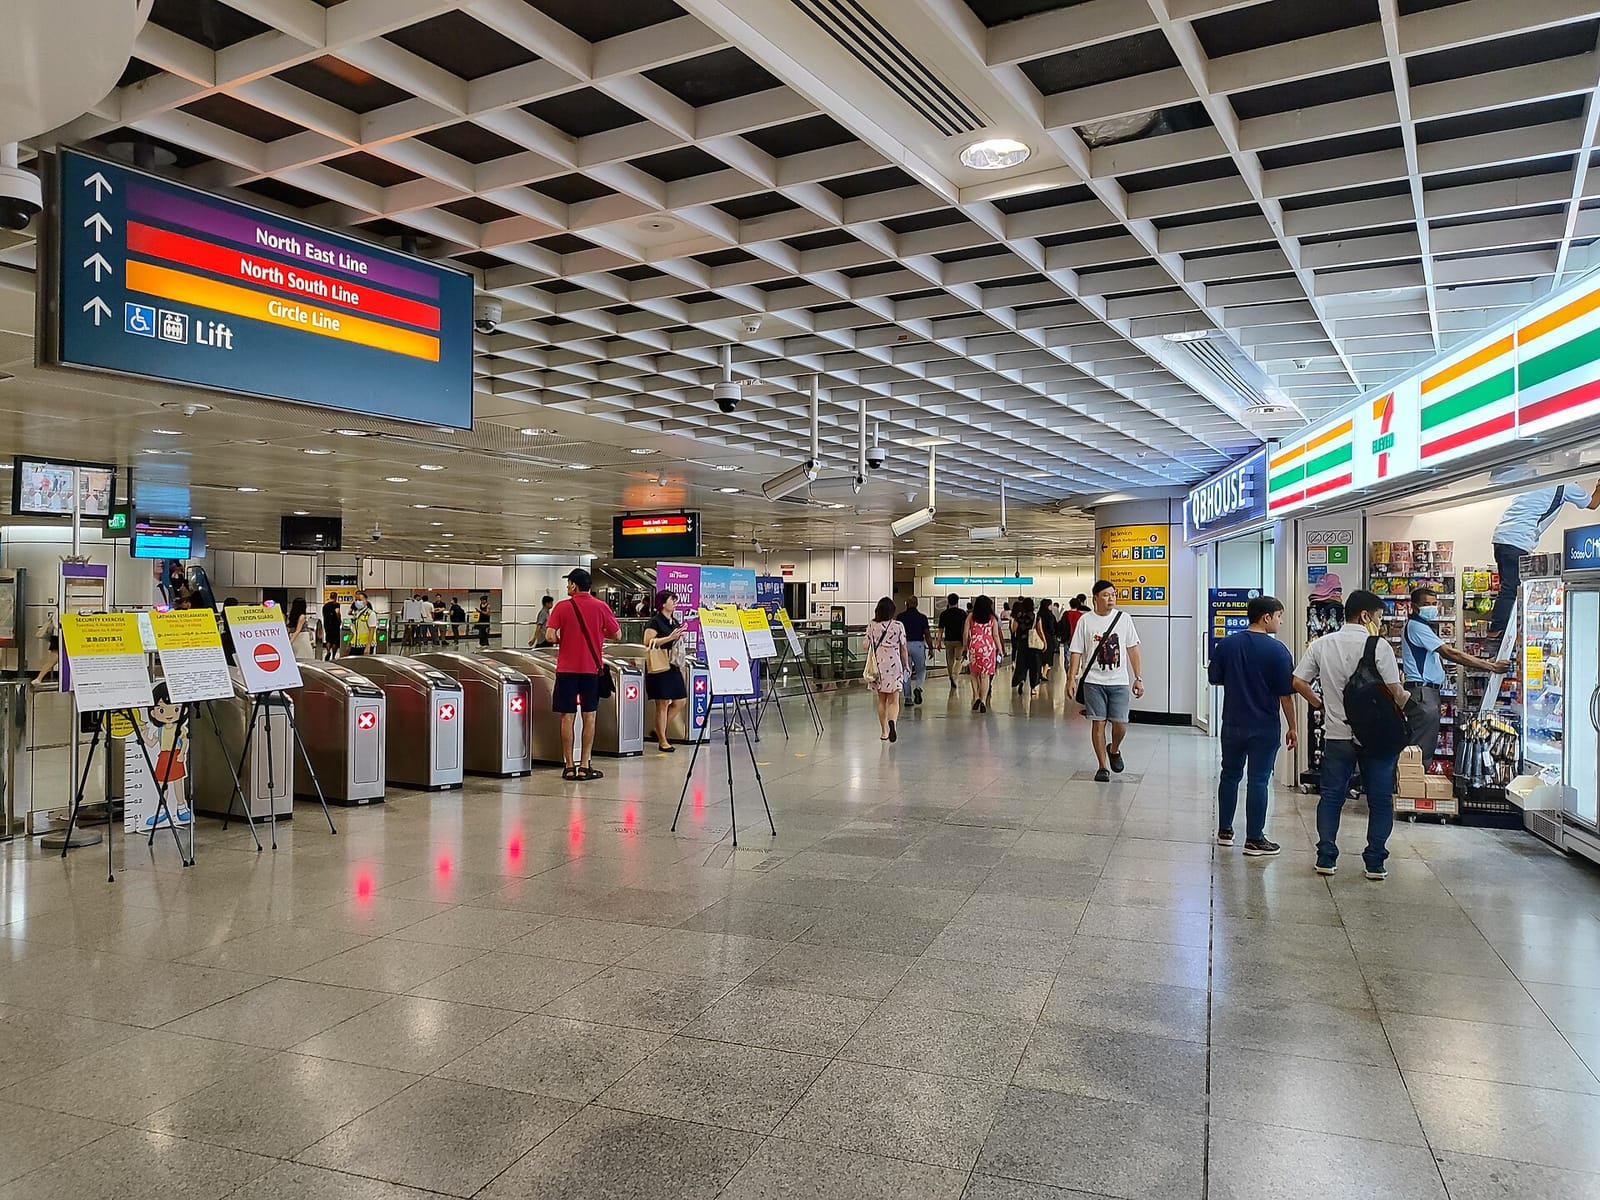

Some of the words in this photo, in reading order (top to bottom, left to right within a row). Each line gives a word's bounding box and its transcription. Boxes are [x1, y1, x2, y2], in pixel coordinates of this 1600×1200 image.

[256, 227, 300, 255] North
[305, 242, 335, 265] East
[339, 252, 368, 274] Line
[241, 258, 284, 285] North
[288, 272, 327, 297] South
[332, 284, 359, 305] Line
[268, 300, 308, 323] Circle
[312, 311, 340, 331] Line
[196, 320, 234, 350] Lift
[1373, 391, 1395, 478] 7
[1134, 551, 1140, 559] B
[1146, 550, 1151, 559] 1
[665, 583, 693, 593] HIRING
[674, 593, 690, 603] OW!
[1134, 592, 1139, 600] E
[1146, 592, 1152, 600] 2
[239, 630, 253, 639] NO
[255, 627, 280, 638] ENTRY
[708, 631, 719, 639] TO
[720, 631, 740, 640] TRAIN
